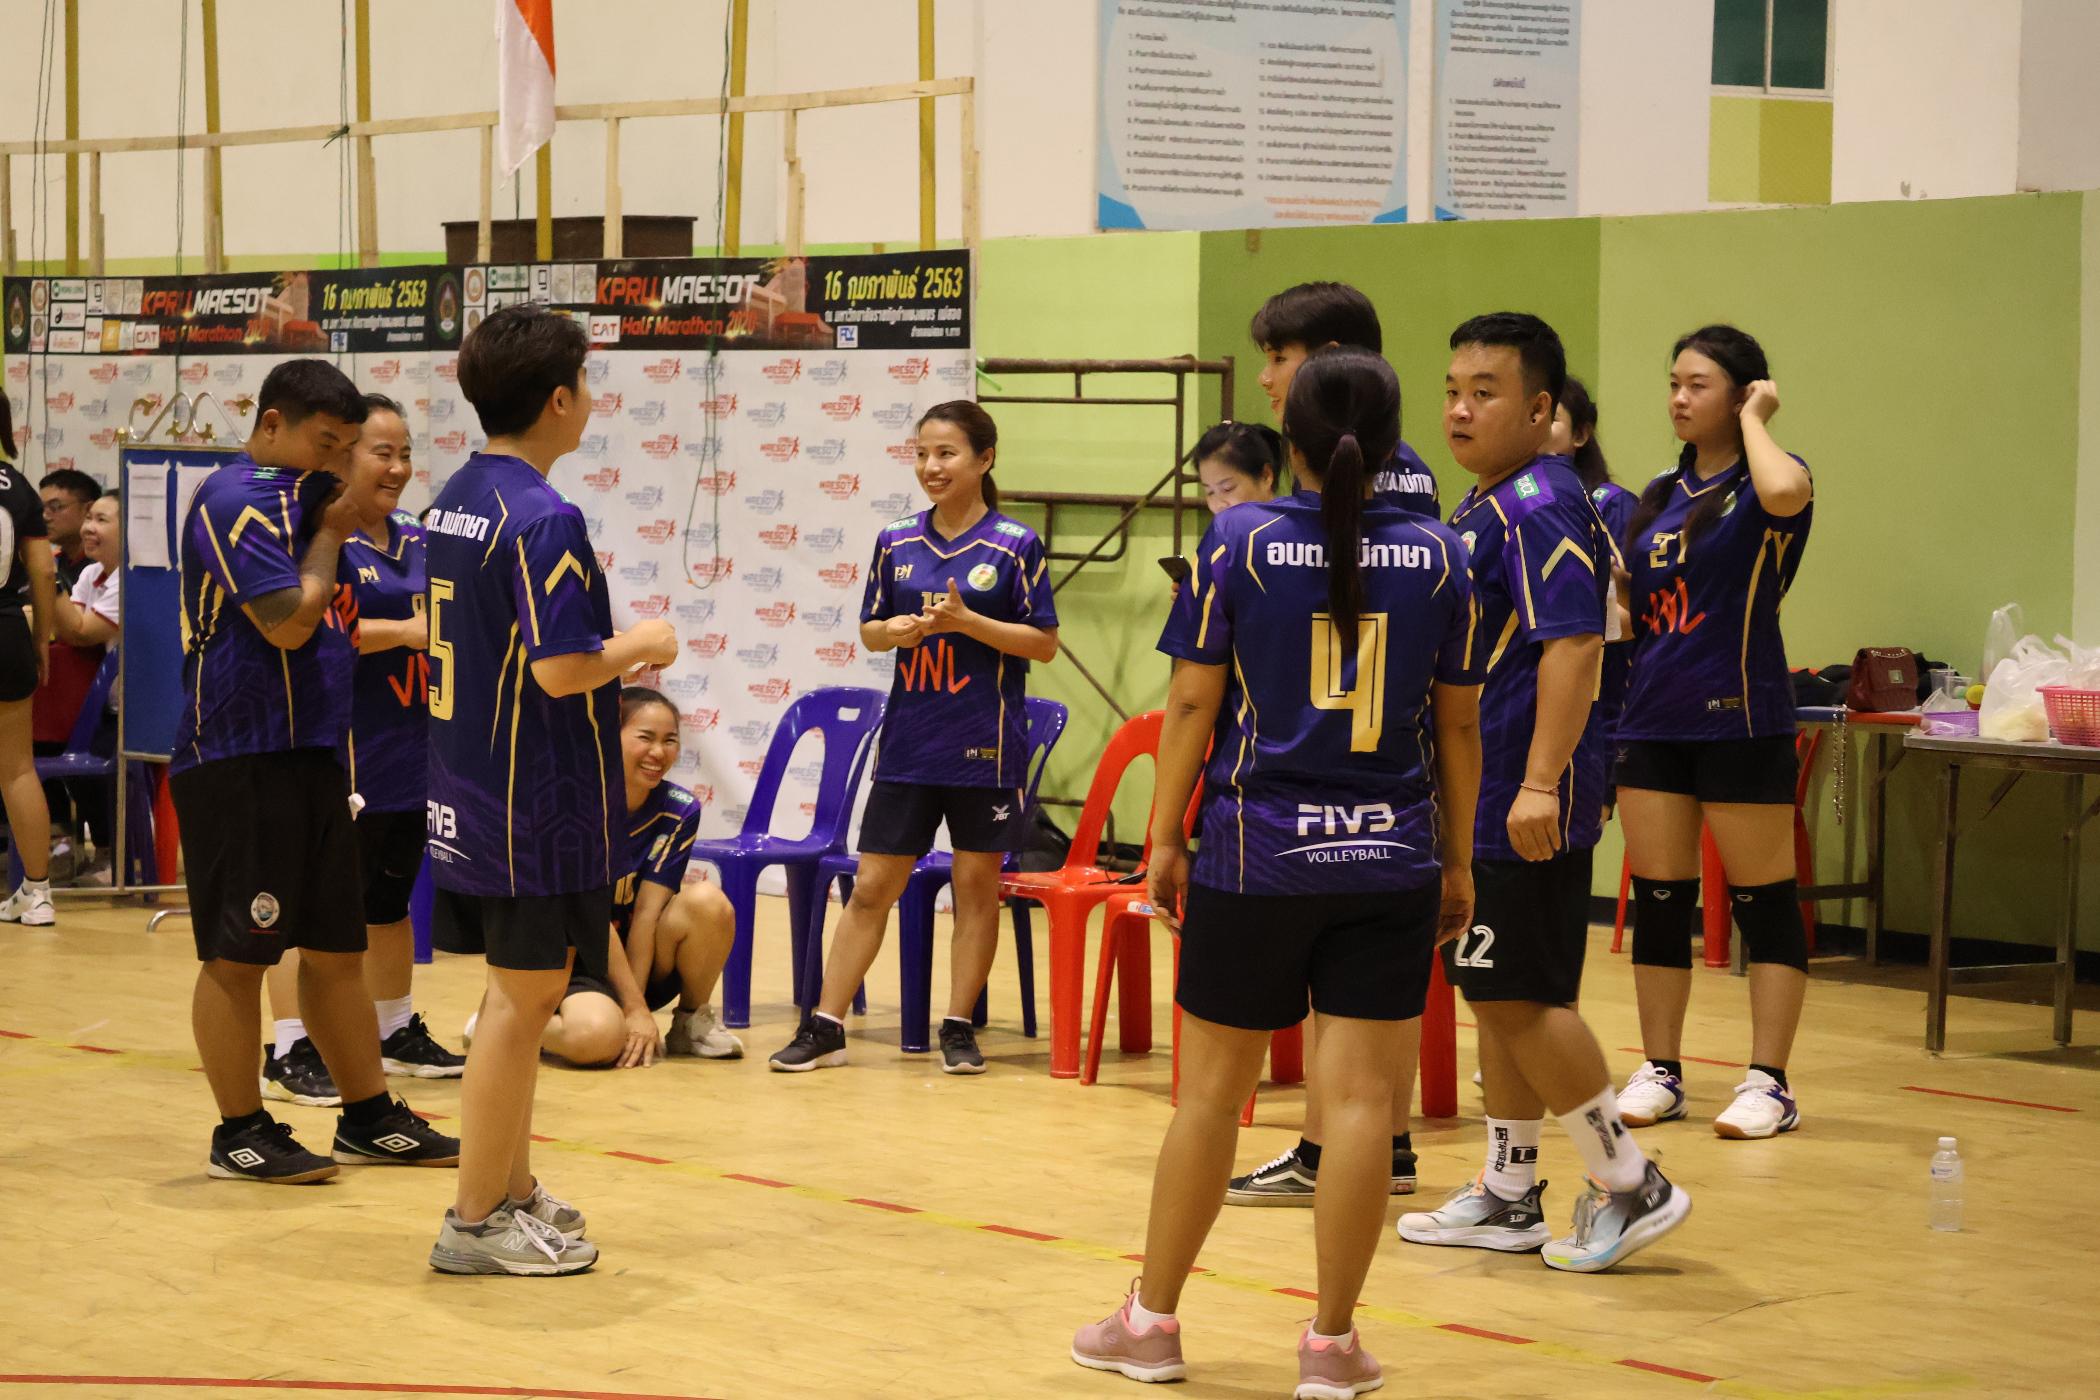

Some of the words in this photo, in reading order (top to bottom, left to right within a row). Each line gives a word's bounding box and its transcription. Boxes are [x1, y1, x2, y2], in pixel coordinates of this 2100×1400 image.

[192, 286, 273, 315] MAESOT
[323, 283, 338, 310] 16
[396, 279, 428, 308] 2563
[597, 276, 661, 305] KPRU
[661, 274, 760, 304] MAESOT
[824, 270, 843, 301] 16
[848, 265, 920, 307] กุมภาพันธ์
[923, 266, 964, 299] 2563
[136, 331, 157, 343] CAT
[591, 322, 617, 337] CAT
[620, 316, 655, 336] Half
[654, 315, 724, 336] Marathon
[428, 577, 455, 721] 5
[899, 638, 971, 695] VNL
[1309, 612, 1389, 752] 4
[1297, 802, 1397, 837] FIVB
[1306, 847, 1392, 863] VOLLEYBALL
